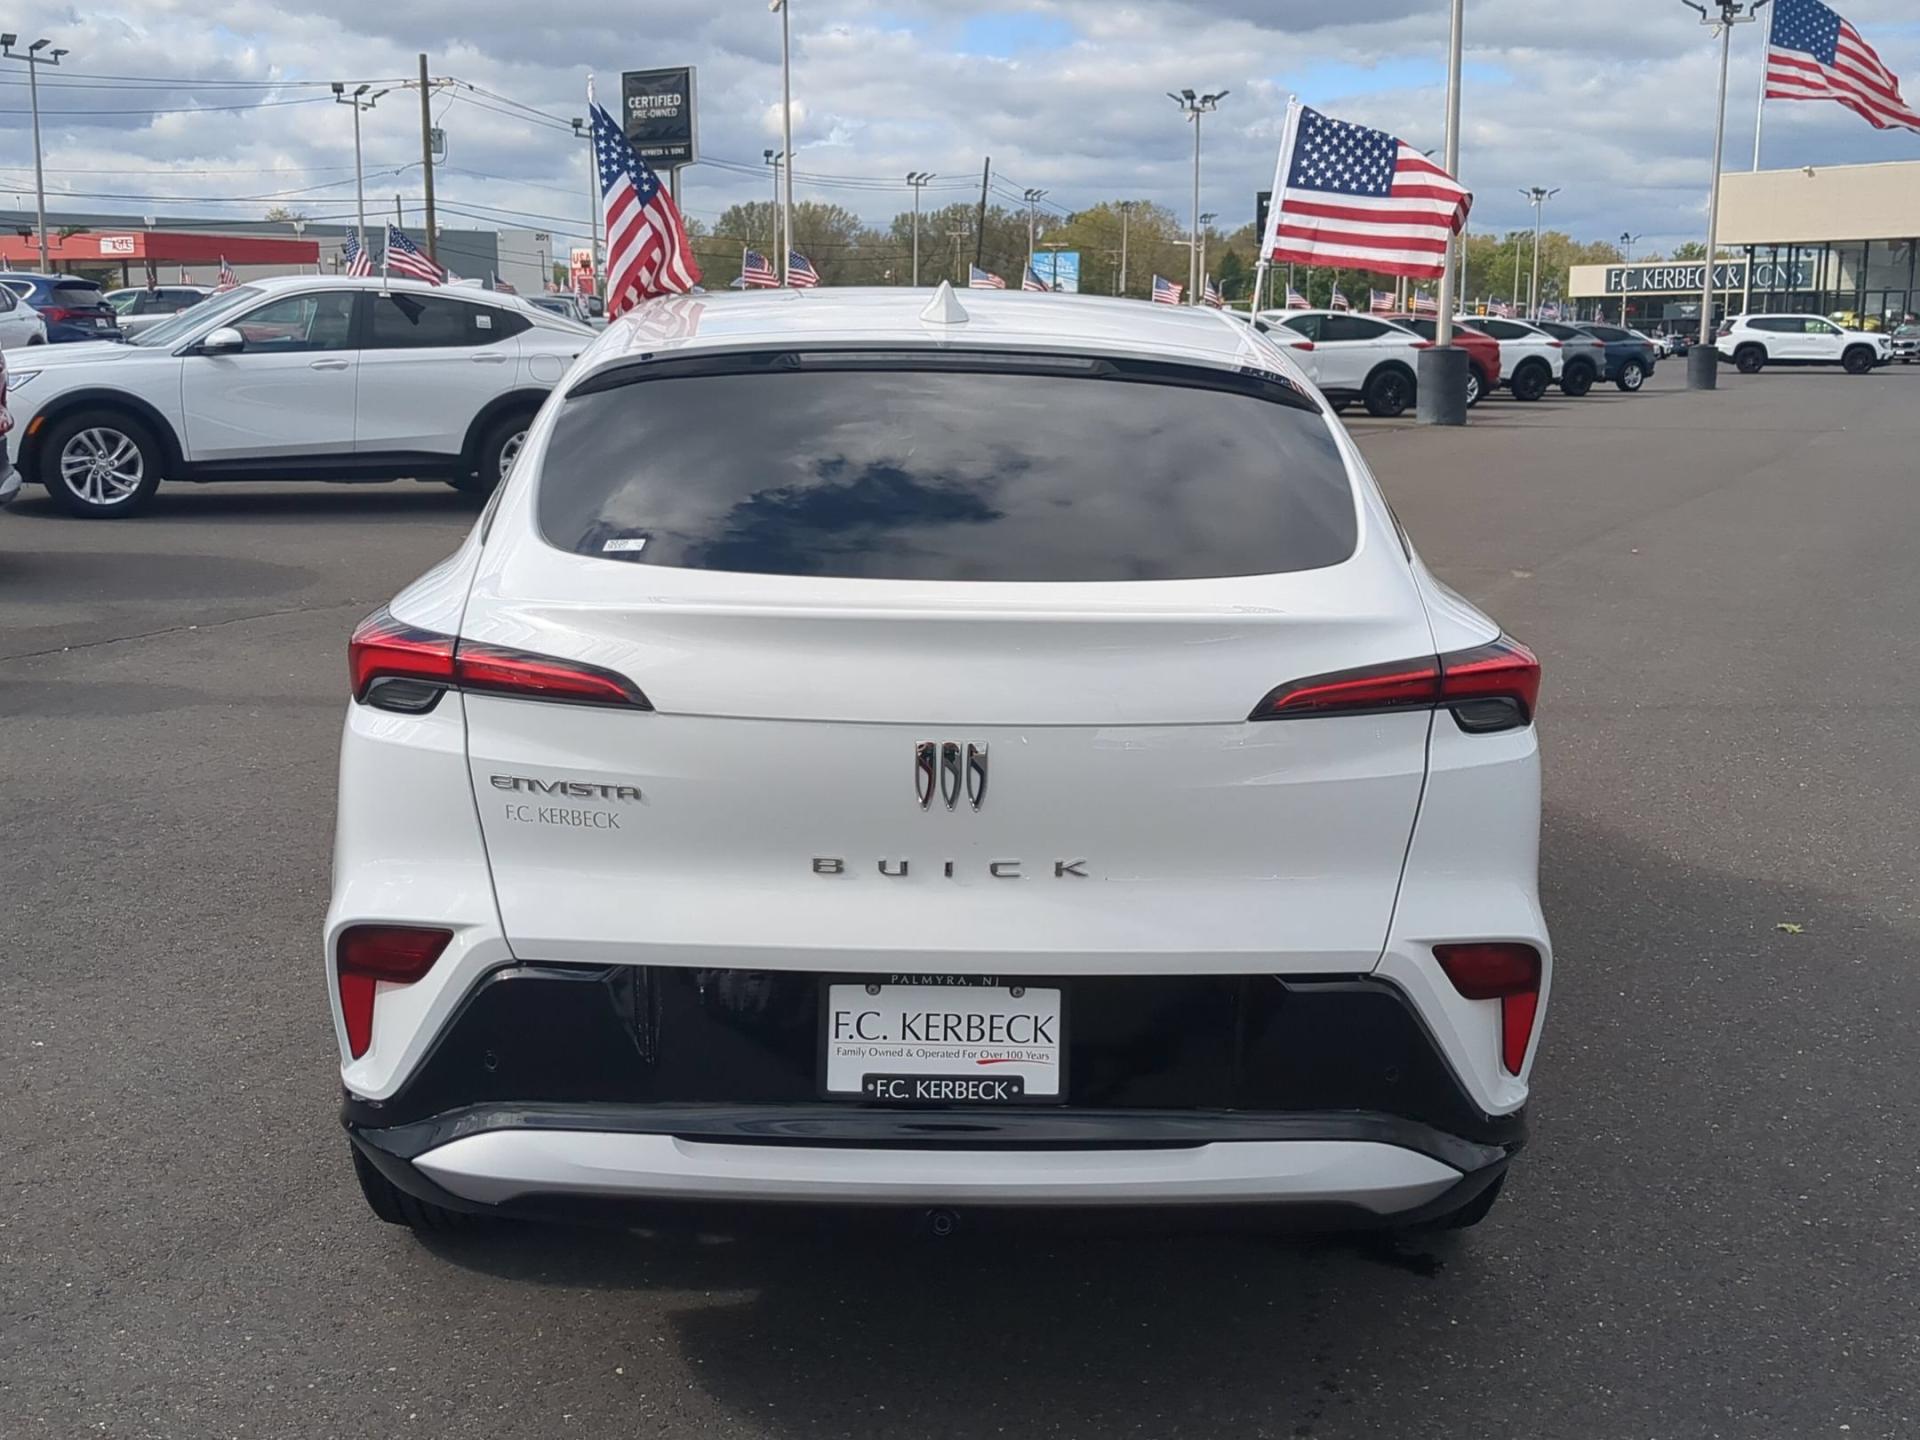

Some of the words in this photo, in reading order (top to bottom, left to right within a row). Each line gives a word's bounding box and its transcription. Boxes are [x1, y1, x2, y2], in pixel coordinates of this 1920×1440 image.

[628, 94, 681, 109] CERTIFIED
[632, 108, 678, 119] PRE-OWNED
[535, 233, 549, 241] 201
[1610, 270, 1637, 291] F.C.
[1642, 266, 1721, 289] KERBECK
[1725, 265, 1741, 287] &
[1751, 263, 1803, 287] ONS
[490, 775, 642, 800] ENVISTA
[506, 804, 533, 822] F.C.
[538, 807, 621, 829] KERBECK
[812, 858, 1089, 878] BUICK
[891, 974, 973, 987] PALMYRA,
[834, 1010, 888, 1041] F.C.
[901, 1012, 1055, 1044] KERBECK
[836, 1047, 866, 1059] Family
[868, 1047, 903, 1057] Owned
[906, 1049, 913, 1058] &
[916, 1049, 960, 1060] Operated
[962, 1050, 977, 1059] For
[980, 1050, 1002, 1060] Over
[1006, 1050, 1023, 1060] 100
[1027, 1051, 1049, 1061] Years
[876, 1079, 909, 1098] F.C.
[916, 1080, 1008, 1100] KERBECK
